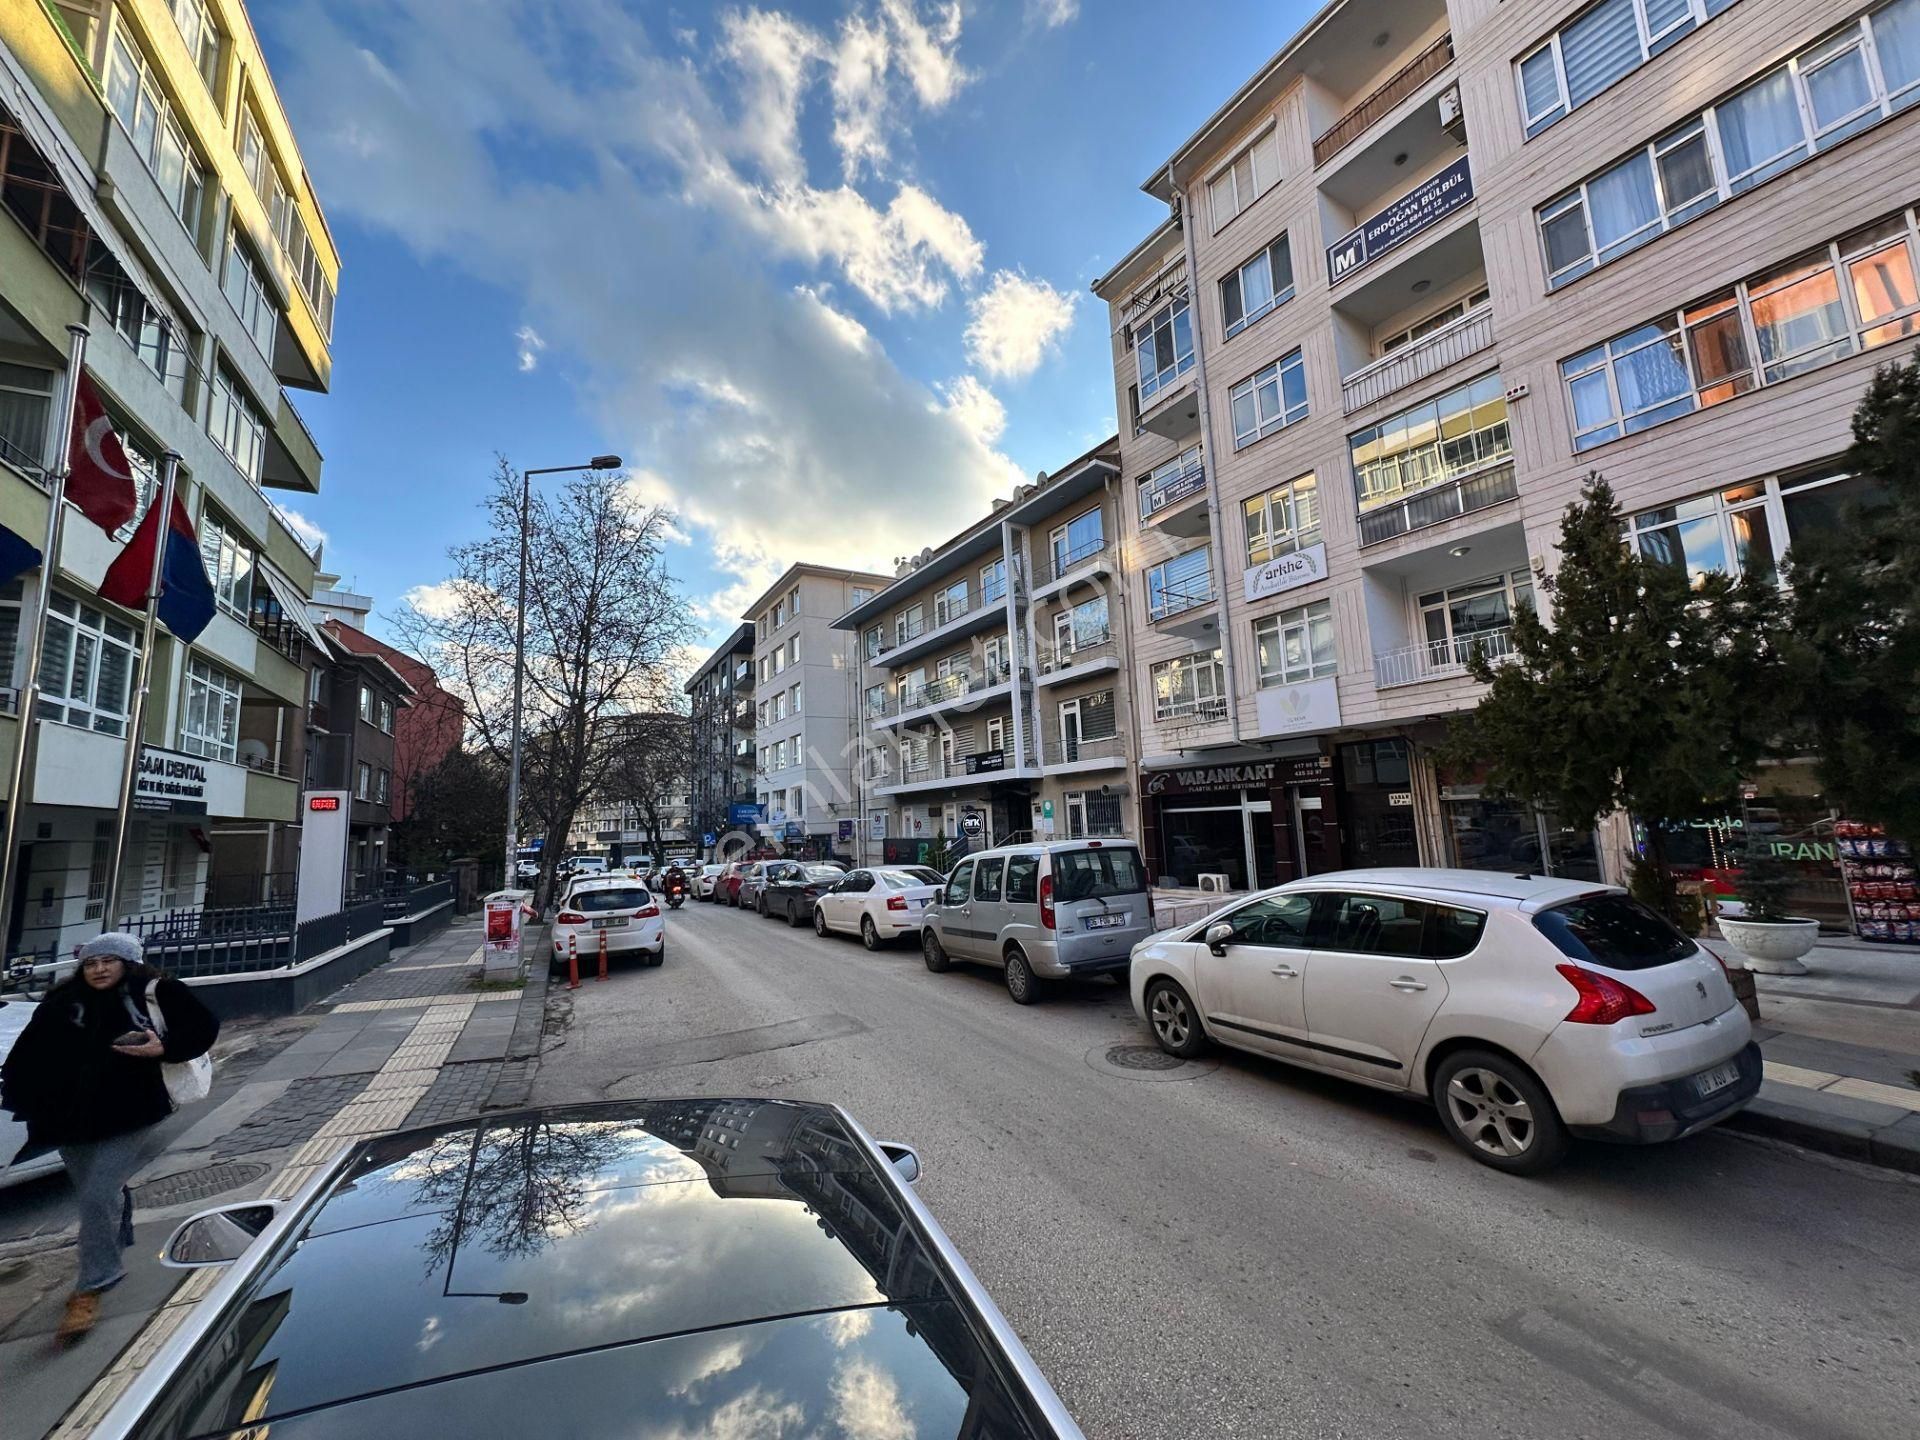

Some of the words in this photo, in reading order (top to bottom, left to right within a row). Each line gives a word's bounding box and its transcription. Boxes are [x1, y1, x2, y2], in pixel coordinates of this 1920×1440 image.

[1367, 201, 1419, 241] ERDOĞAN
[1420, 172, 1465, 207] BÜLBÜL
[1433, 197, 1443, 209] 12
[1265, 560, 1303, 580] arkhe
[165, 760, 207, 783] DENTAL
[1176, 764, 1276, 786] VARANKART
[1770, 842, 1835, 861] IRAN
